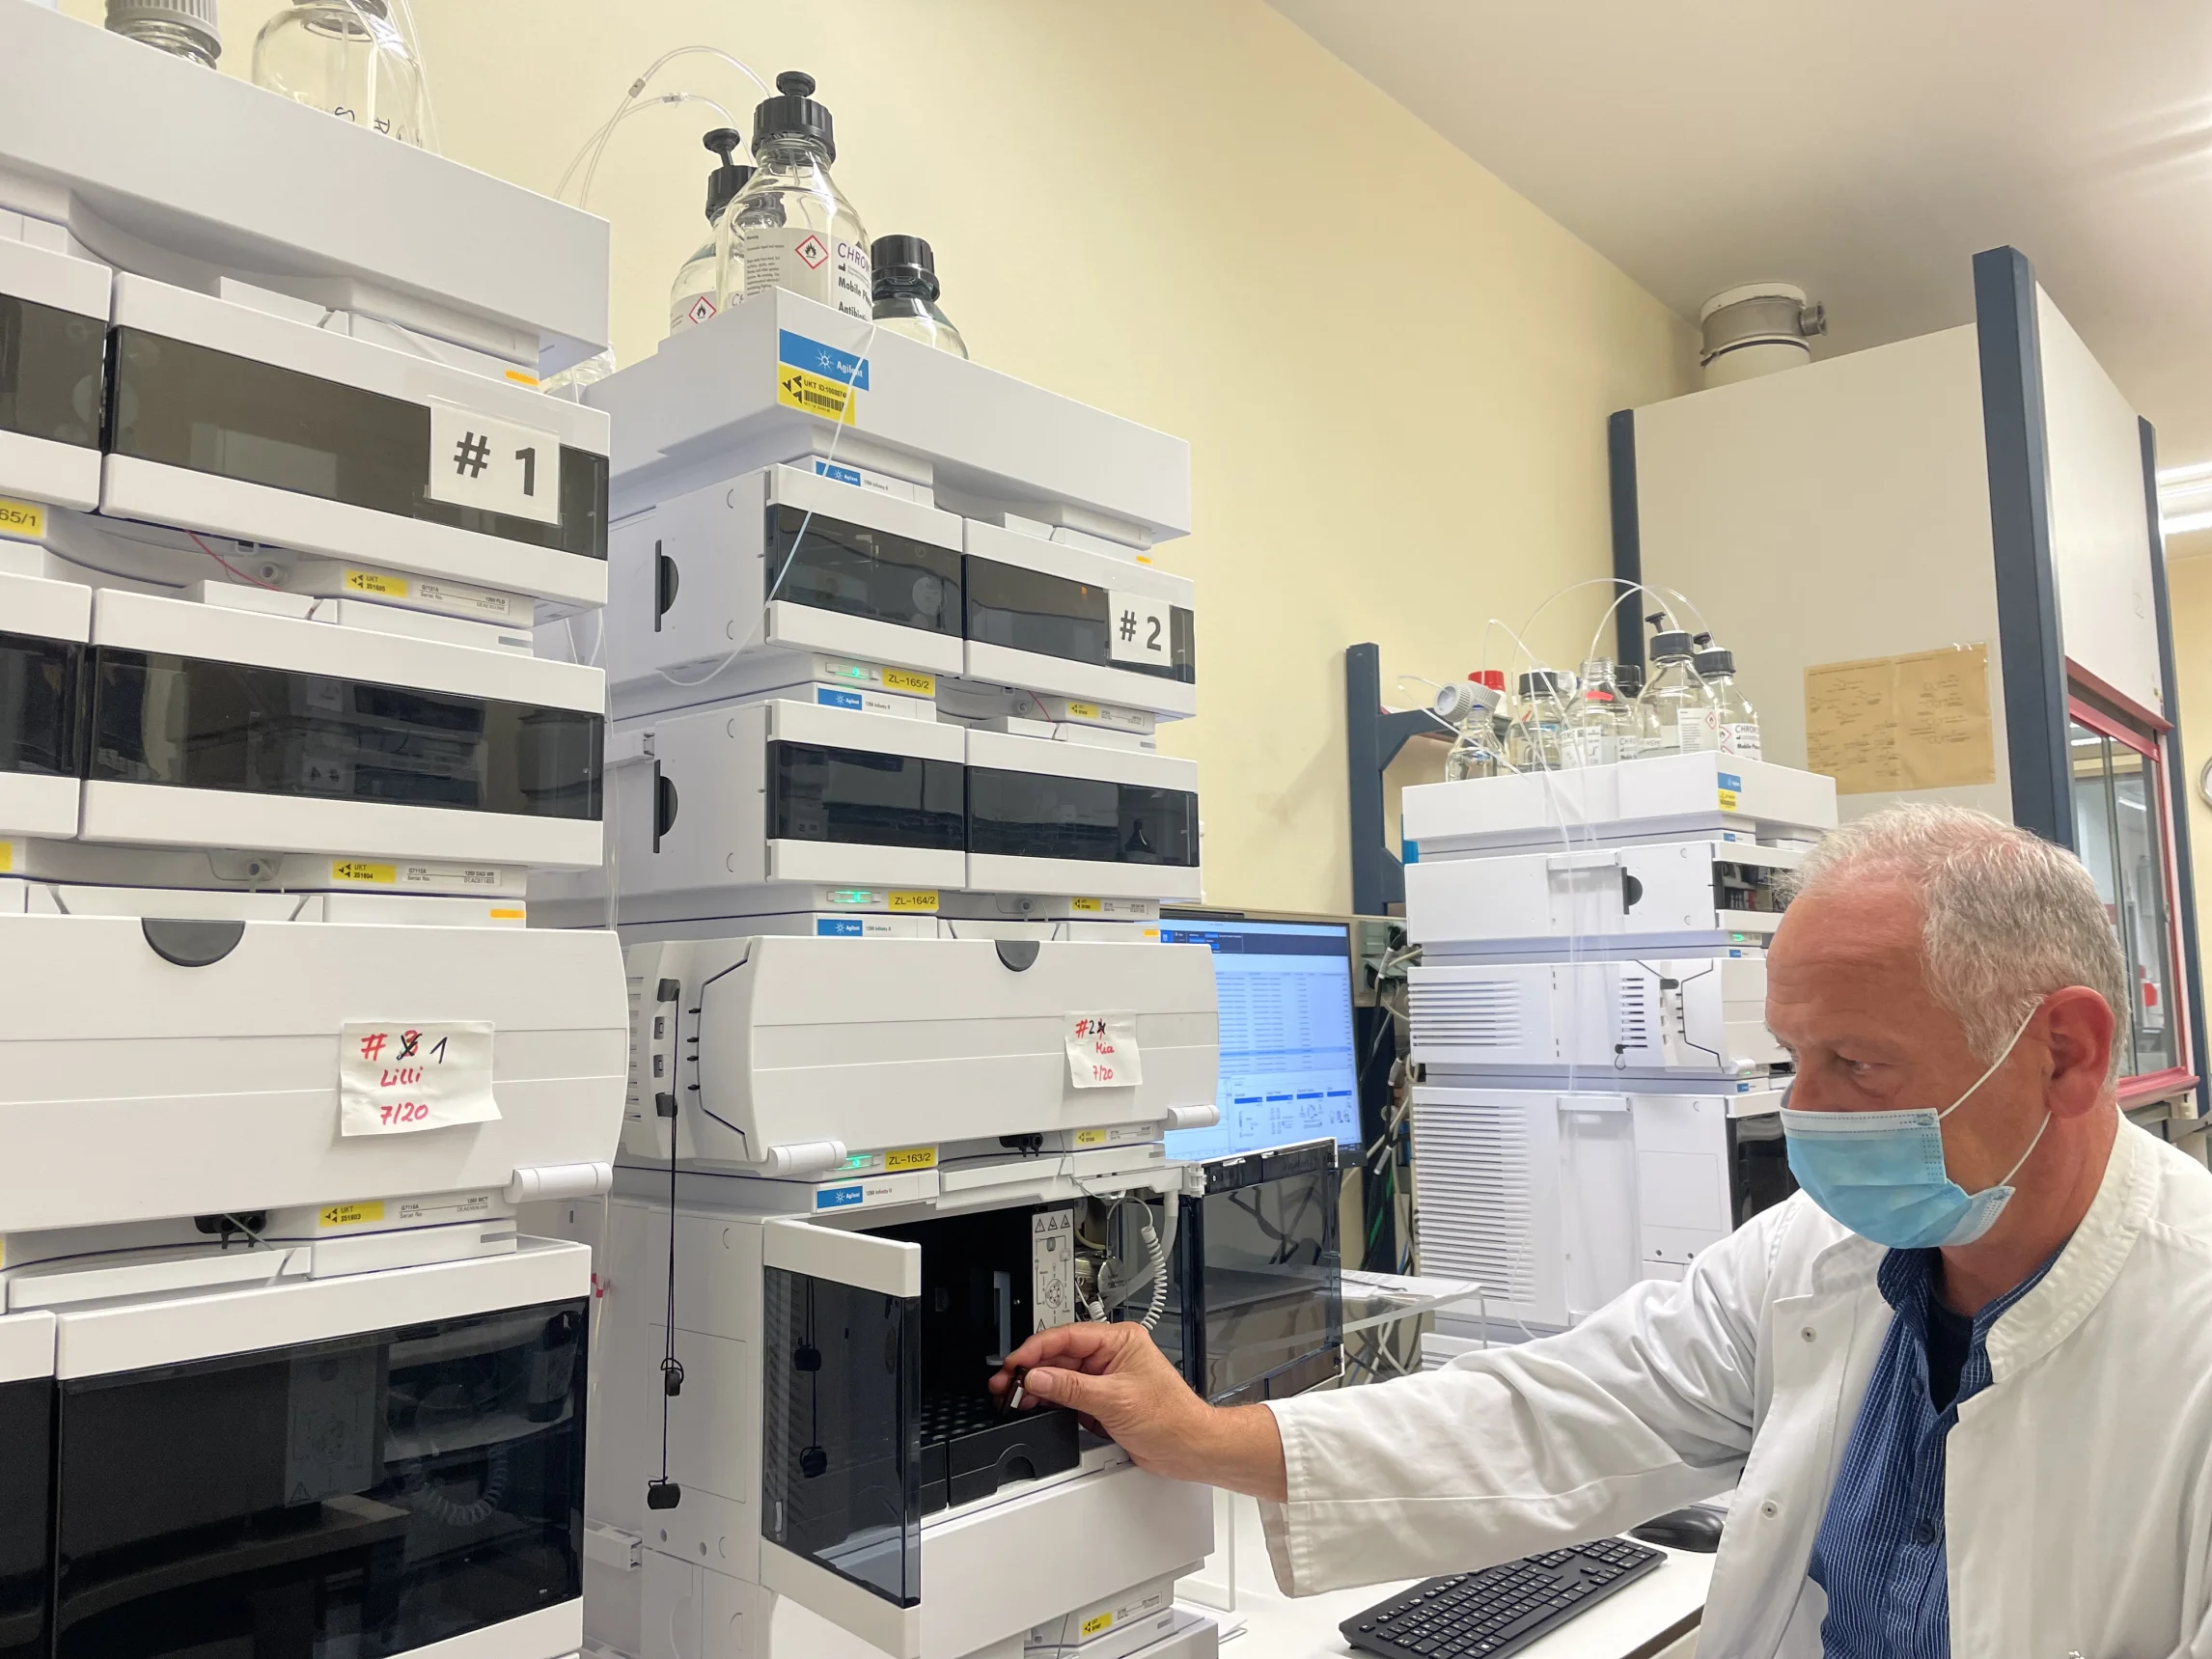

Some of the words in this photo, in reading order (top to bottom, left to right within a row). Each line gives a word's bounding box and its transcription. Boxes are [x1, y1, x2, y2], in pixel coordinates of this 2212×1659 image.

[838, 276, 862, 297] Mobile
[803, 378, 817, 390] UKT
[454, 430, 490, 479] #
[515, 446, 536, 497] 1
[0, 508, 37, 527] 65/1
[1120, 610, 1137, 642] #
[1147, 616, 1161, 651] 2
[888, 674, 929, 690] ZL-165/2
[894, 896, 935, 905] ZL-164/2
[360, 1033, 388, 1062] #
[429, 1036, 448, 1065] 1
[380, 1065, 424, 1088] Lilli
[1092, 1065, 1114, 1083] 7/20
[380, 1102, 429, 1126] 7/20
[888, 1152, 931, 1166] ZL-163/2
